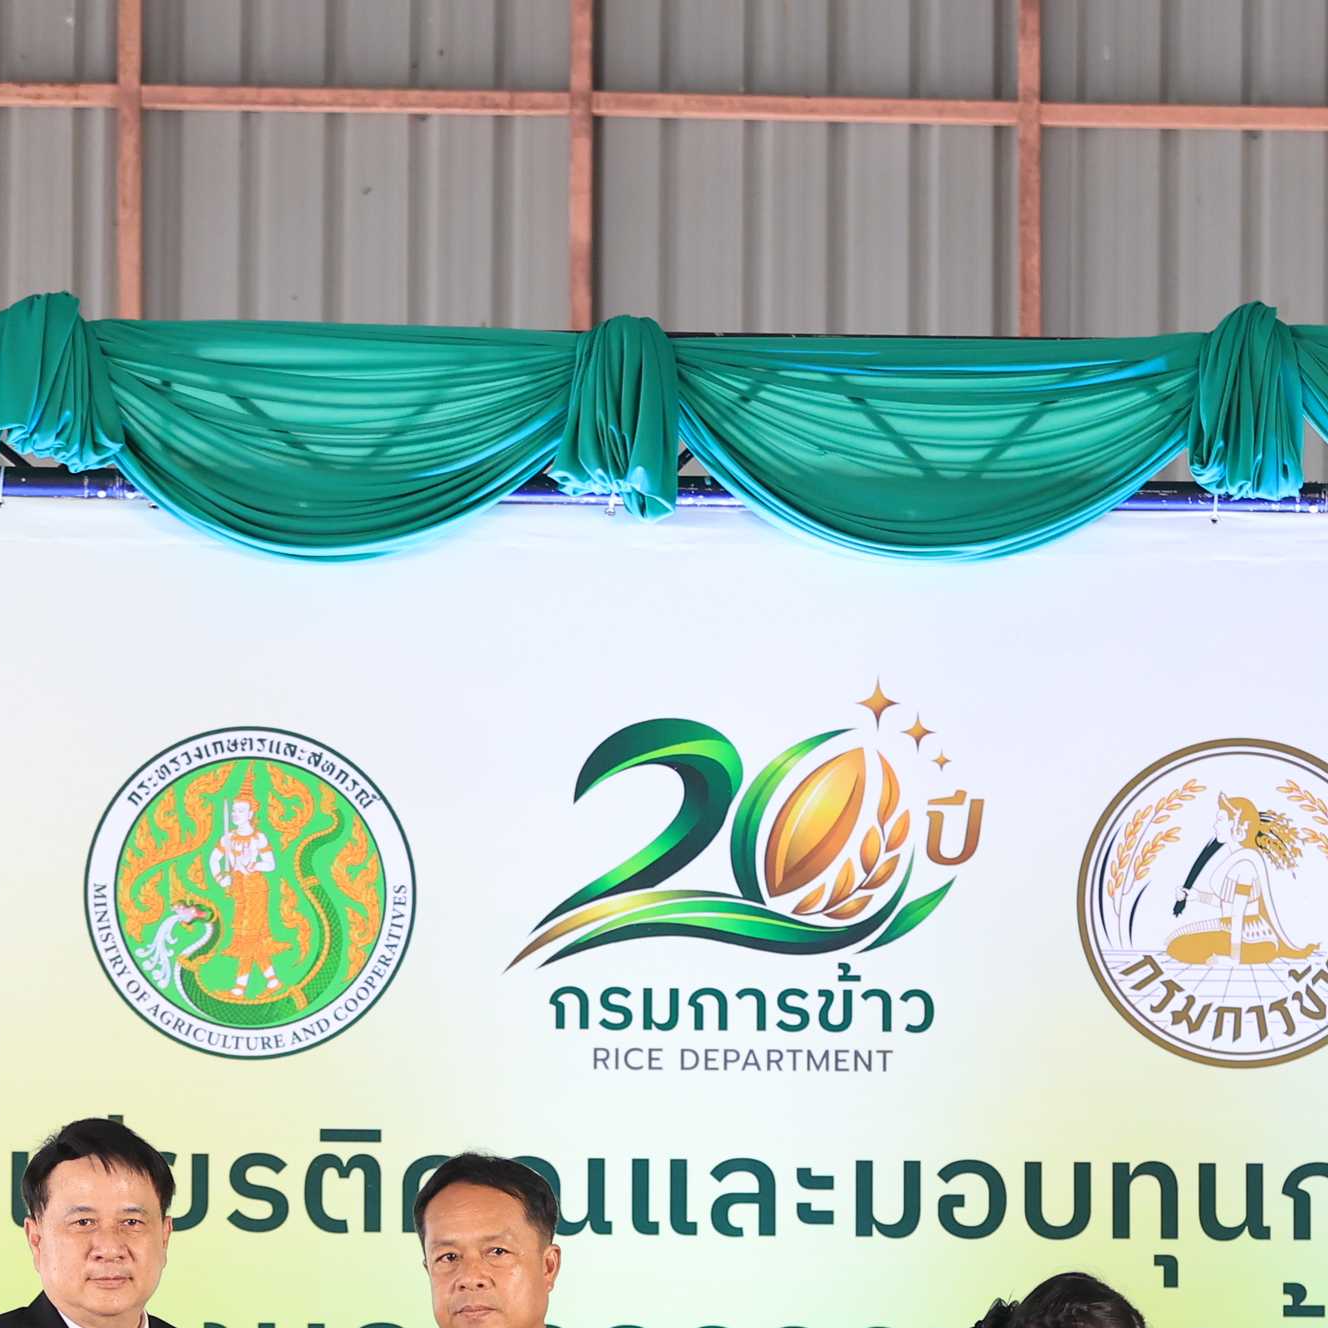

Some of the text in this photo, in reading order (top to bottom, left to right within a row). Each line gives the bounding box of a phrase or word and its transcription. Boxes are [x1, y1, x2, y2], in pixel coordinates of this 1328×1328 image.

[925, 789, 985, 866] ปี
[93, 882, 408, 1050] MINISTRY OF AGRICULTURE AND COOPERATIVES
[549, 962, 935, 1033] กรมการข้าว
[592, 1046, 894, 1073] RICE DEPARTMENT
